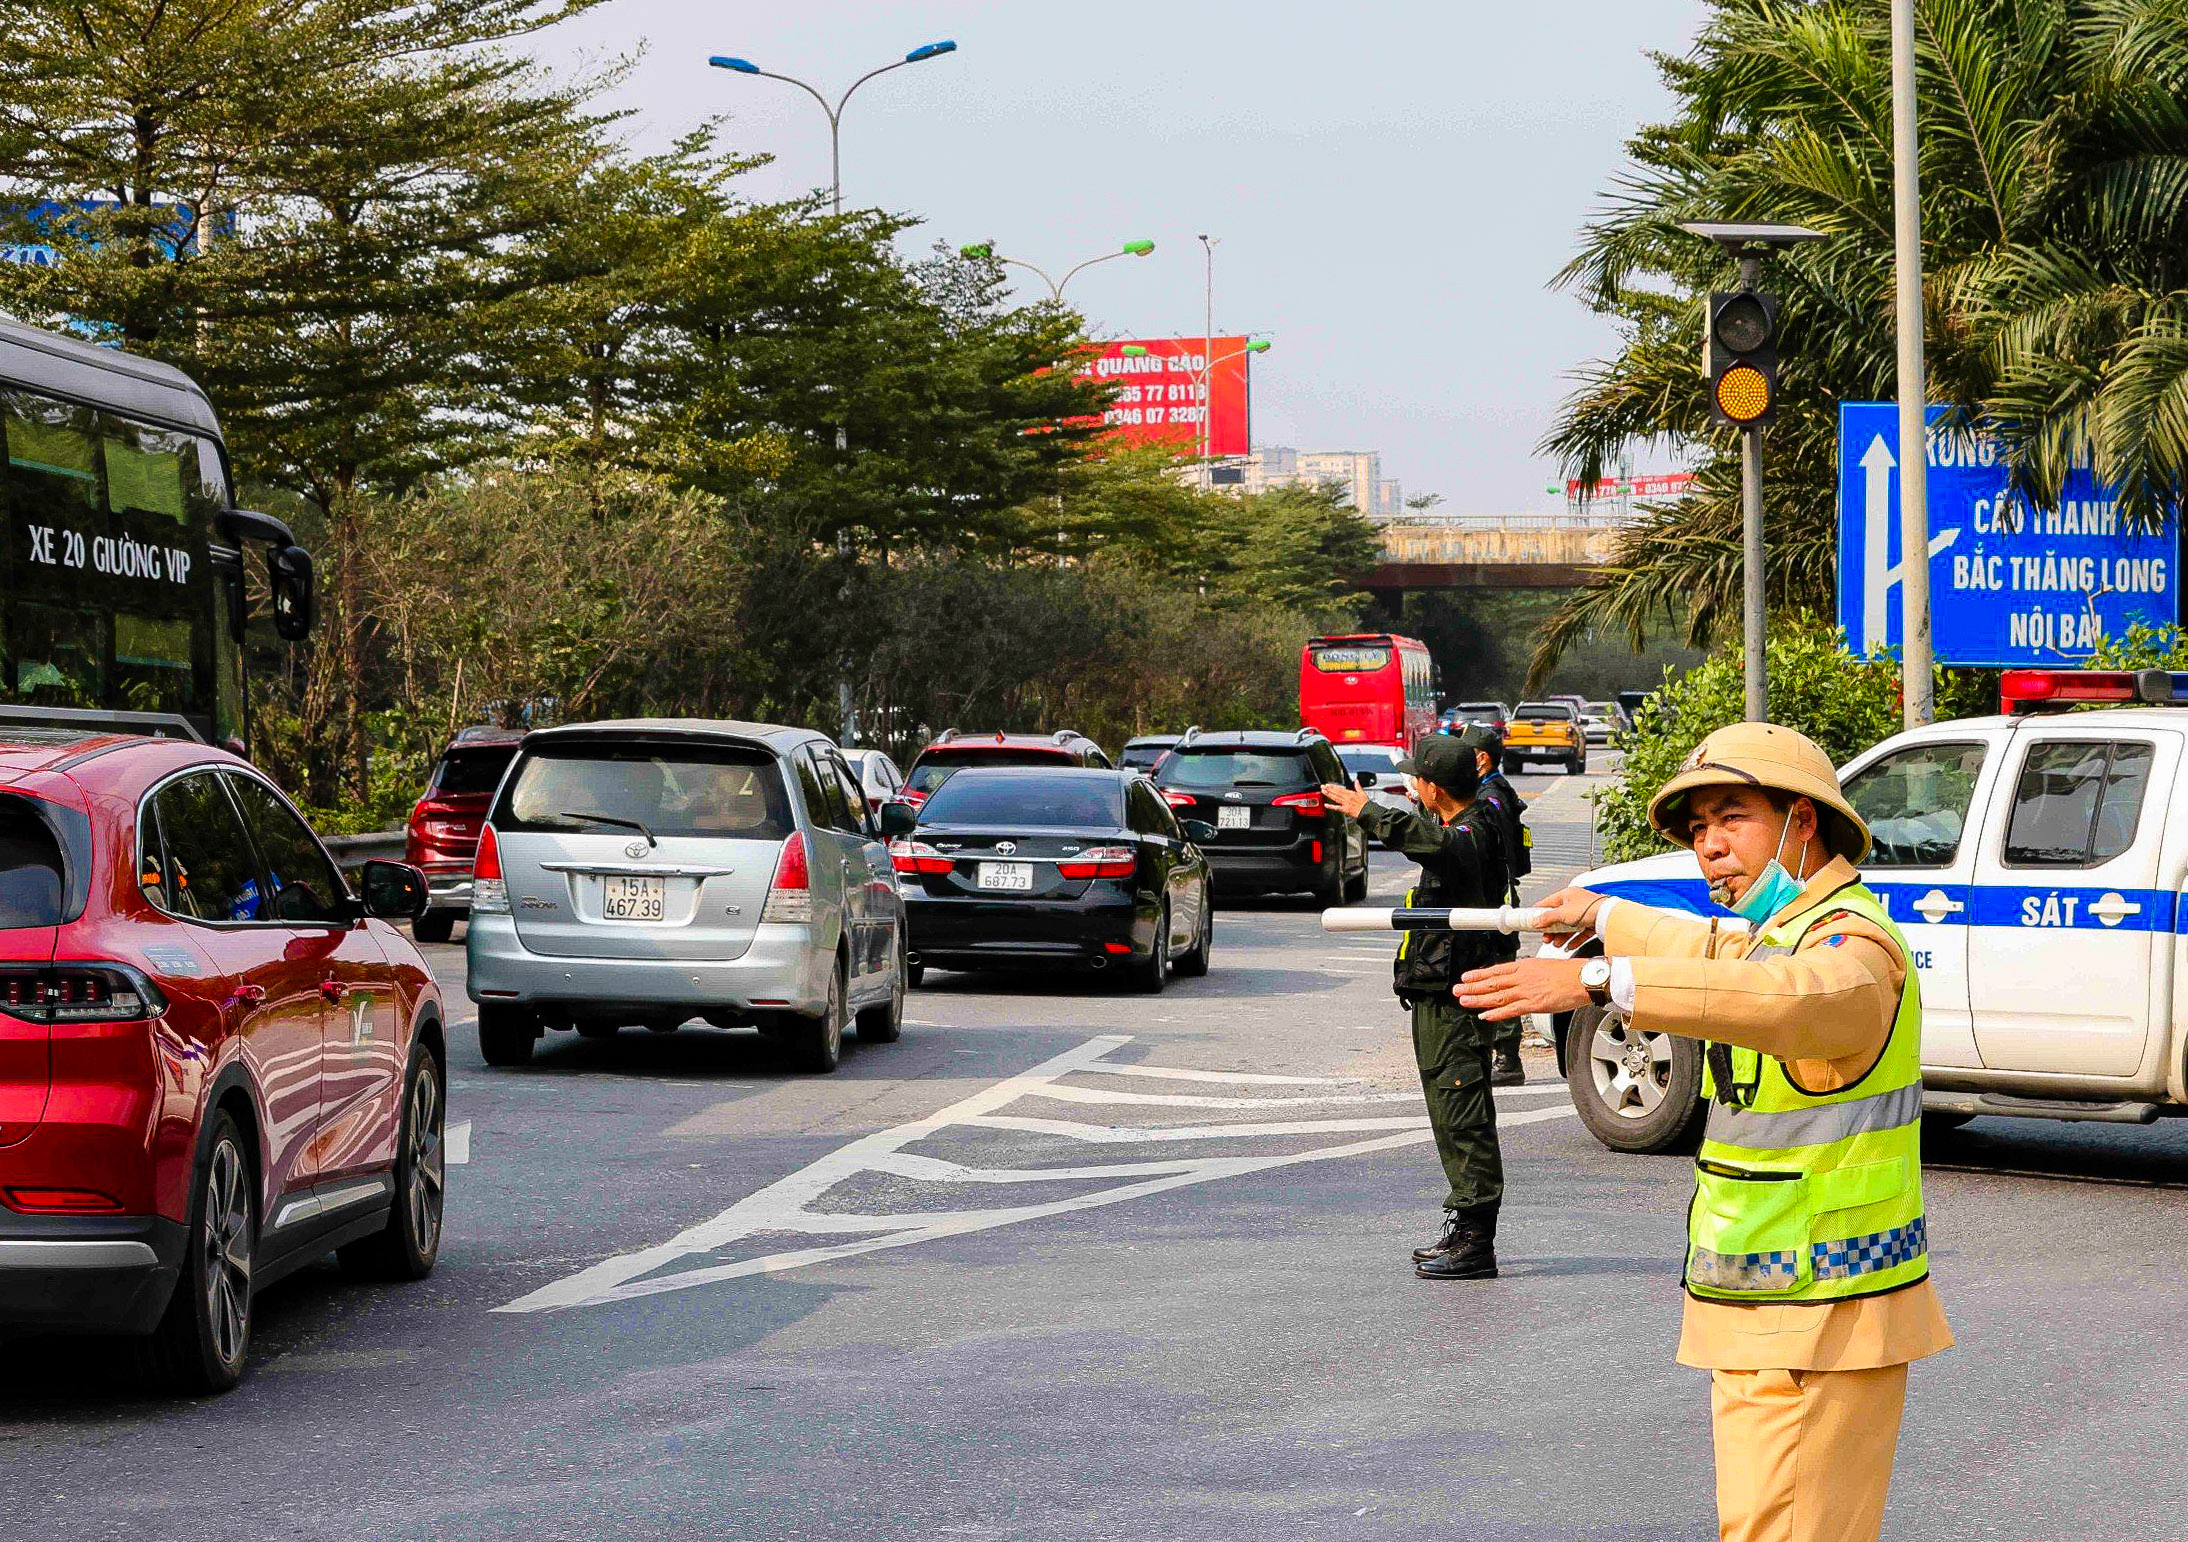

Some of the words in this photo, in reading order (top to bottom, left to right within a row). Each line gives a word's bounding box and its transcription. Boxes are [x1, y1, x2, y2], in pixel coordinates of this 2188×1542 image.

[28, 524, 57, 565] XE
[62, 529, 86, 569] 20
[92, 531, 161, 580] GIƯỜNG
[164, 547, 191, 584] VIP
[1953, 542, 2003, 591] BẮC
[2010, 550, 2095, 592] THĂNG
[2101, 558, 2167, 593] LONG
[995, 863, 1017, 876] 20A
[620, 877, 650, 898] 15A
[984, 875, 1026, 888] 687.73
[606, 898, 662, 918] 467.39
[2021, 891, 2079, 928] SÁT
